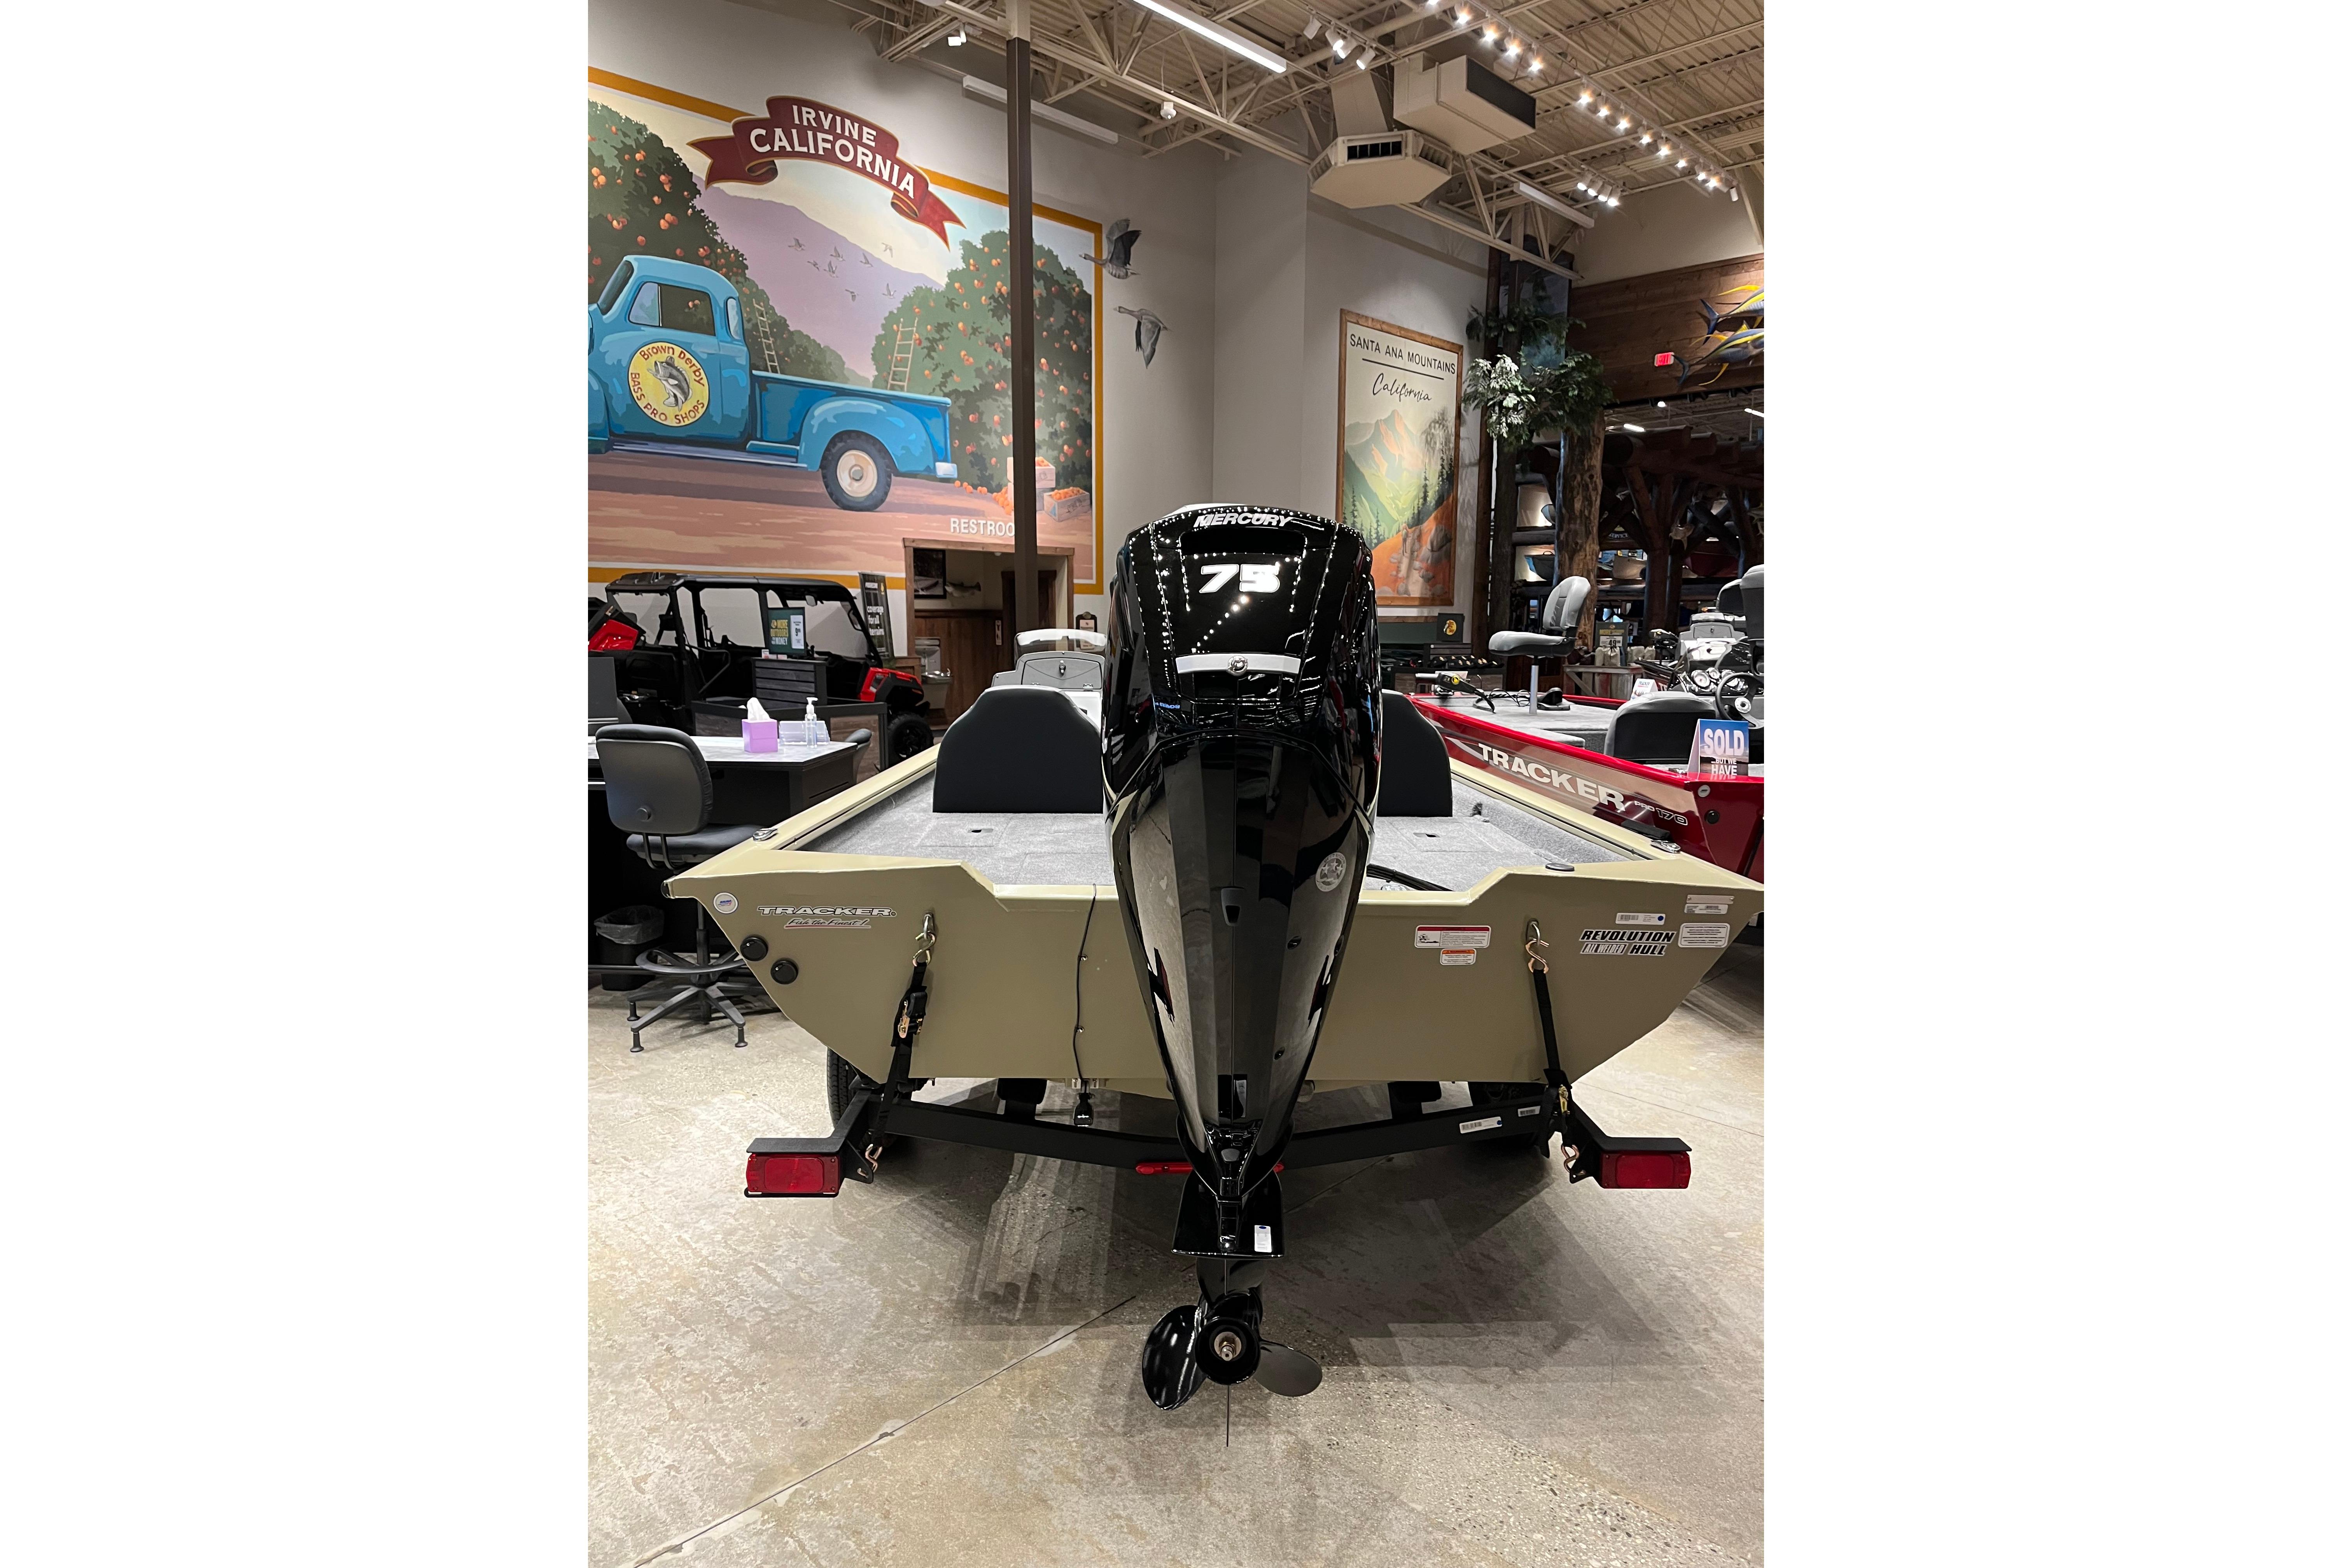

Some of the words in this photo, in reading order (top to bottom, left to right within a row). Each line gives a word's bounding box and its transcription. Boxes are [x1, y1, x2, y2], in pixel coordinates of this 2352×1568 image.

[793, 105, 877, 147] IRVINE
[750, 128, 914, 199] CALIFORNIA
[639, 345, 675, 361] Brown
[677, 350, 705, 387] Derby
[1350, 333, 1381, 354] SANTA
[1385, 345, 1403, 360] ANA
[1407, 351, 1456, 374] MOUNTAINS
[630, 373, 646, 401] BASS
[643, 402, 668, 422] PRO
[674, 400, 705, 424] SHOPS
[1373, 373, 1432, 402] California
[950, 518, 1015, 537] RESTROO
[1194, 513, 1295, 527] MERCURY
[1199, 564, 1281, 594] 75
[867, 606, 884, 615] coverage
[1704, 728, 1744, 755] SOLD
[1478, 743, 1626, 812] TRACKER
[1711, 765, 1737, 775] HAVE
[1634, 800, 1655, 812] PRO
[1656, 808, 1688, 826] 170
[758, 906, 892, 916] TRACKER
[1580, 930, 1675, 942] REVOLUTION
[1584, 944, 1598, 953] ALL
[1597, 944, 1626, 954] WELDED
[1629, 944, 1666, 955] HULL
